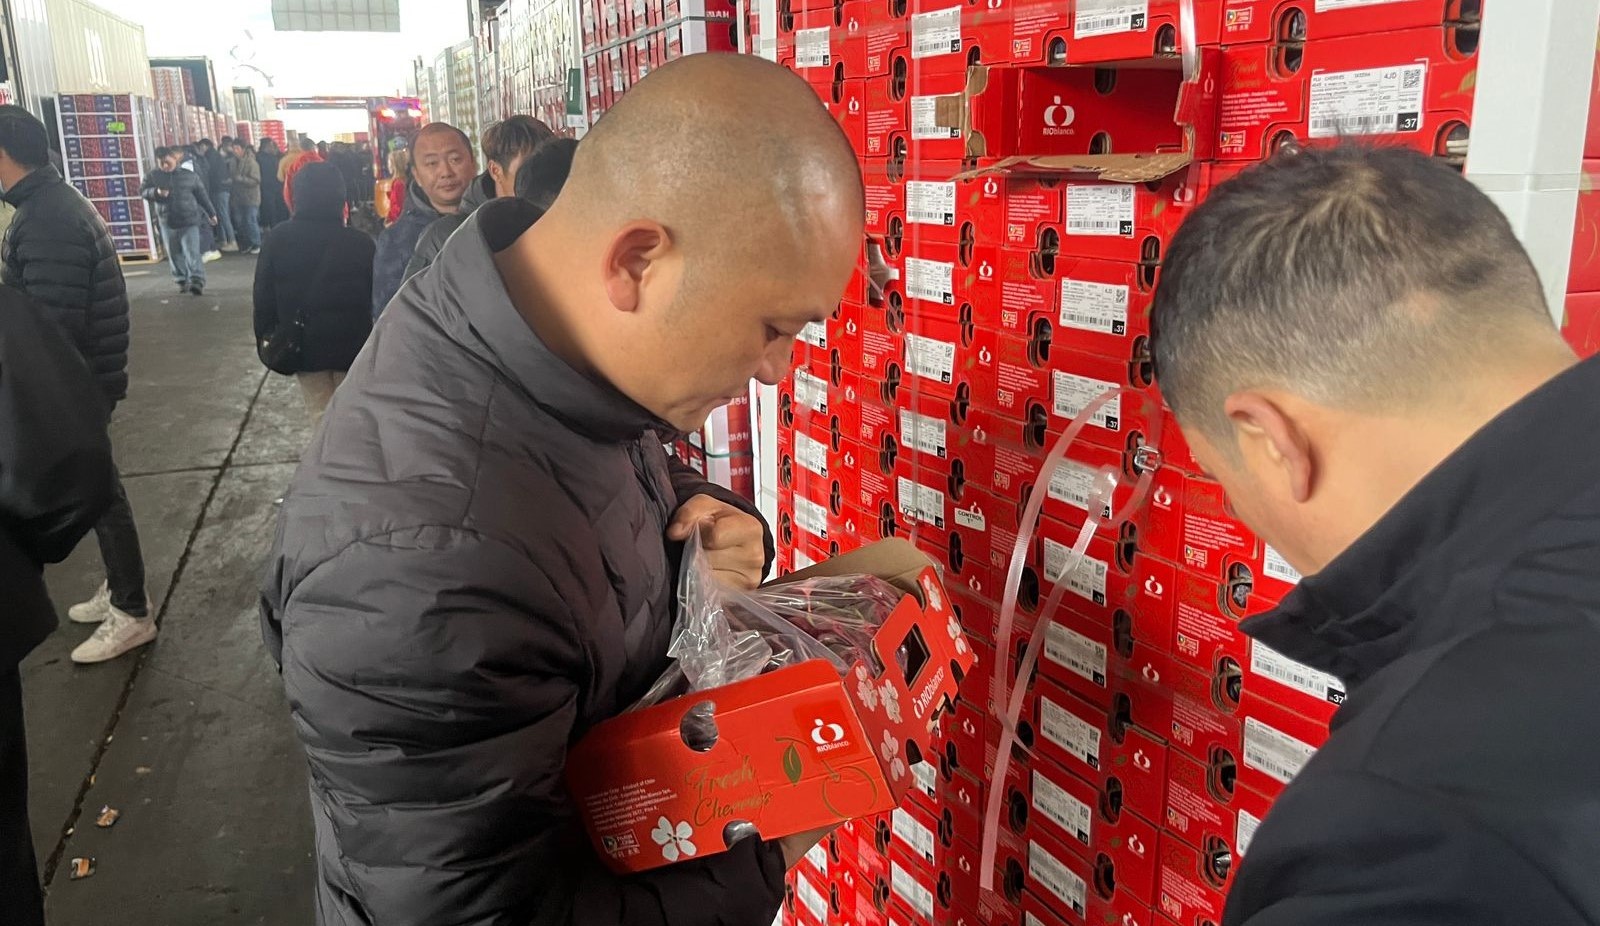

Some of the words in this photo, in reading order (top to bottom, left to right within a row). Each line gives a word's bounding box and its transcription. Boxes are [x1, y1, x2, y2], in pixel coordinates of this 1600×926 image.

[1404, 118, 1417, 128] 37
[1116, 325, 1124, 333] 37
[1110, 421, 1118, 429] 37
[957, 510, 982, 521] CONTROL
[1333, 694, 1344, 704] 37
[685, 755, 756, 801] Fresh
